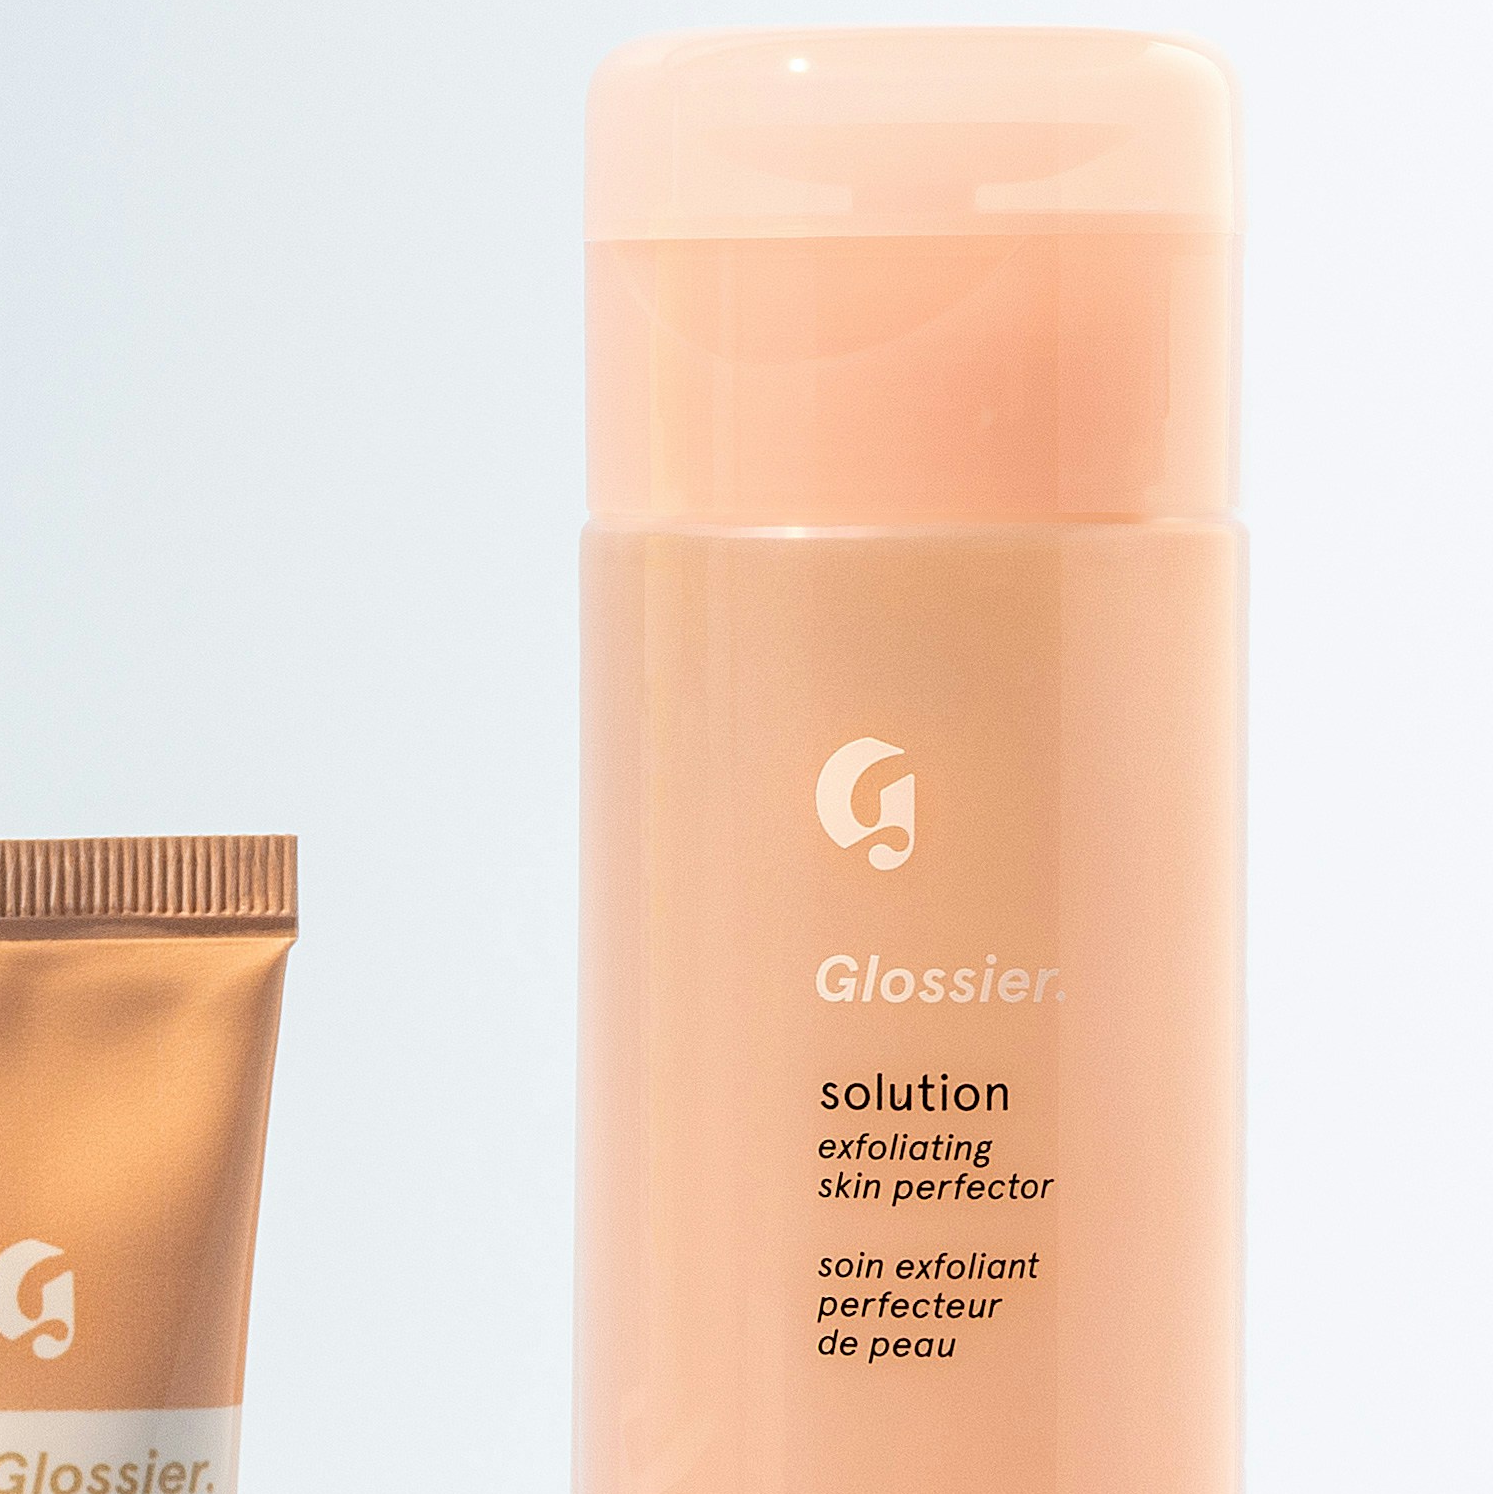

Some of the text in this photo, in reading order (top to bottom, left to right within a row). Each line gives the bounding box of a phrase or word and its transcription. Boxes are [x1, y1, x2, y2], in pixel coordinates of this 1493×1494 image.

[816, 954, 1065, 1003] Glossier.
[821, 1073, 1008, 1111] solution
[818, 1133, 992, 1168] exfoliating
[818, 1171, 1054, 1207] skin perfector
[818, 1252, 1039, 1280] soin exfoliant
[817, 1291, 1002, 1323] perfecteur
[818, 1329, 956, 1364] de peau
